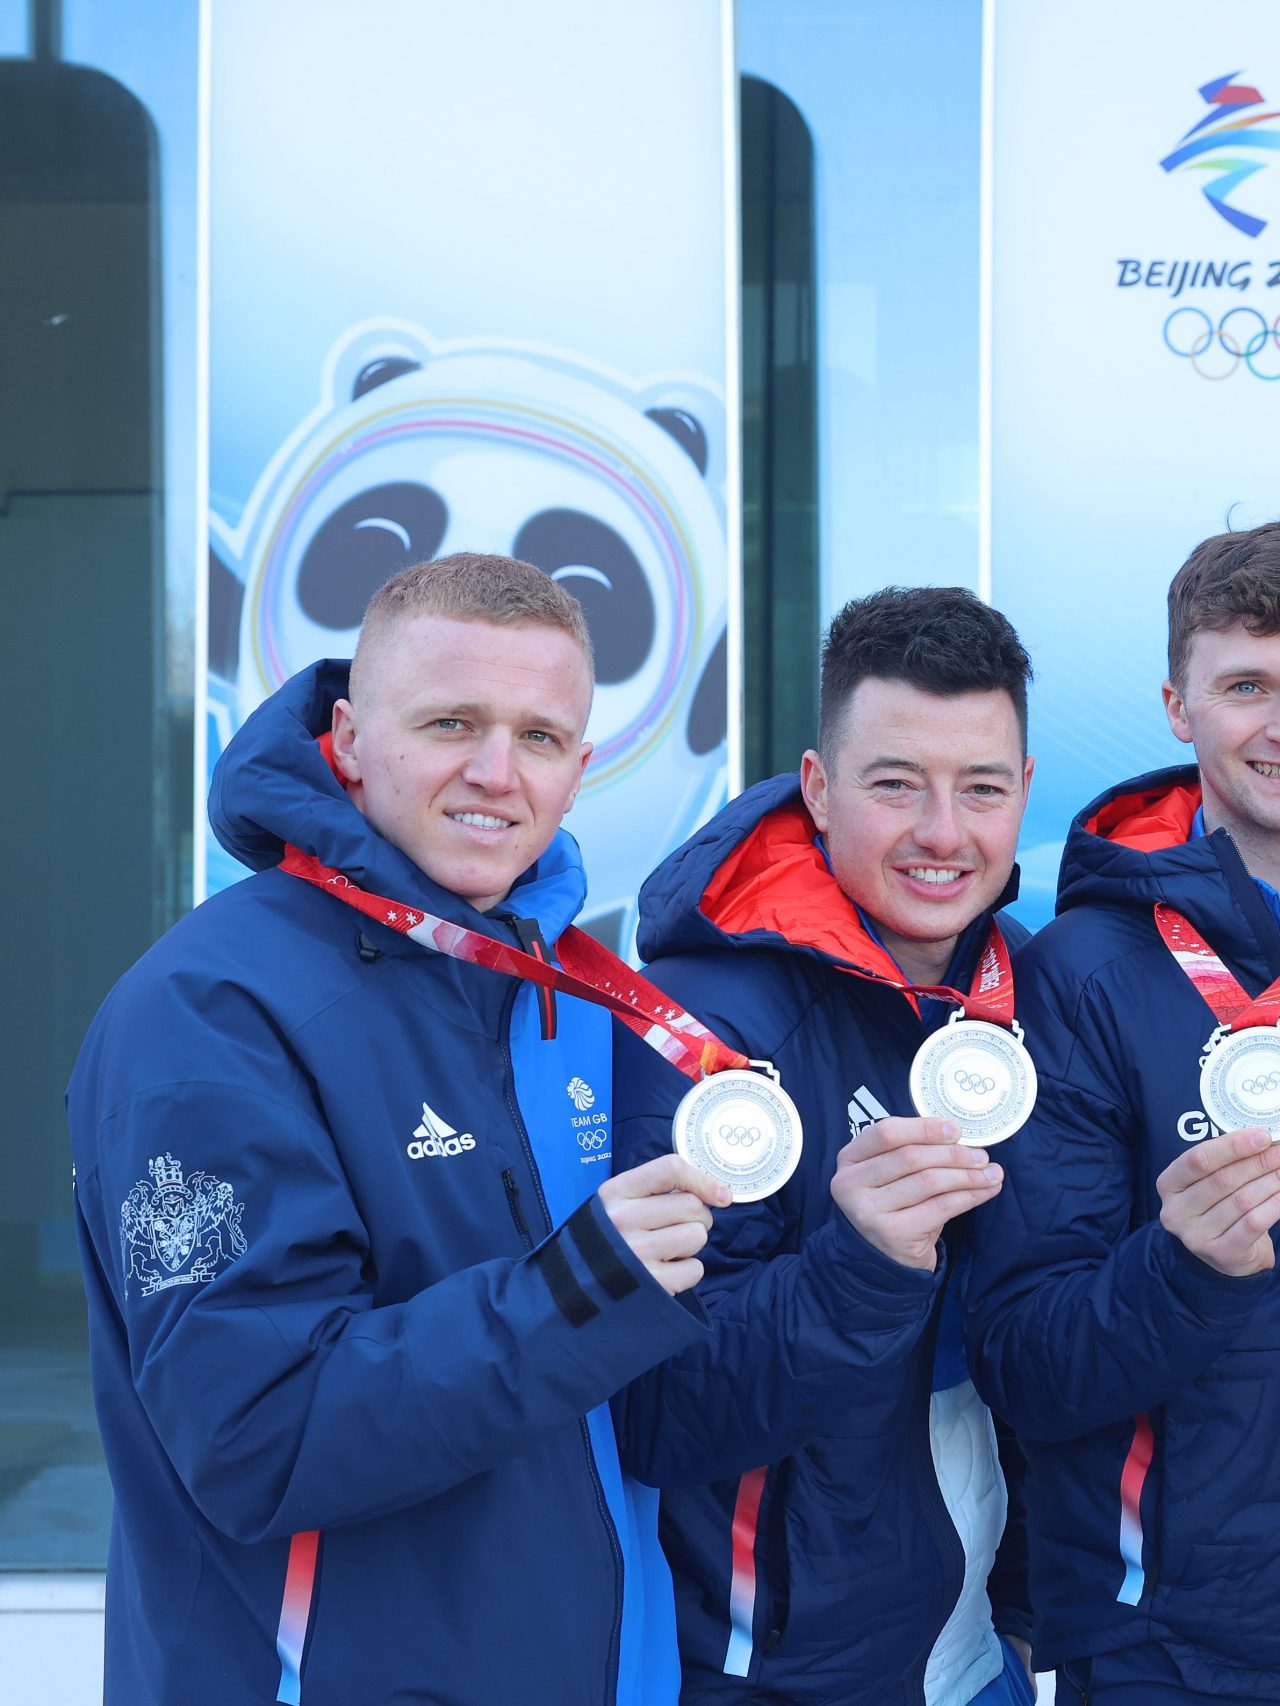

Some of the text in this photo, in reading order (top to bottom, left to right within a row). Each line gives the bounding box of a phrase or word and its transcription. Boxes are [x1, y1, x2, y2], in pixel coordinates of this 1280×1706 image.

[1116, 258, 1252, 299] BEIJING
[571, 1112, 608, 1128] TEAM GB
